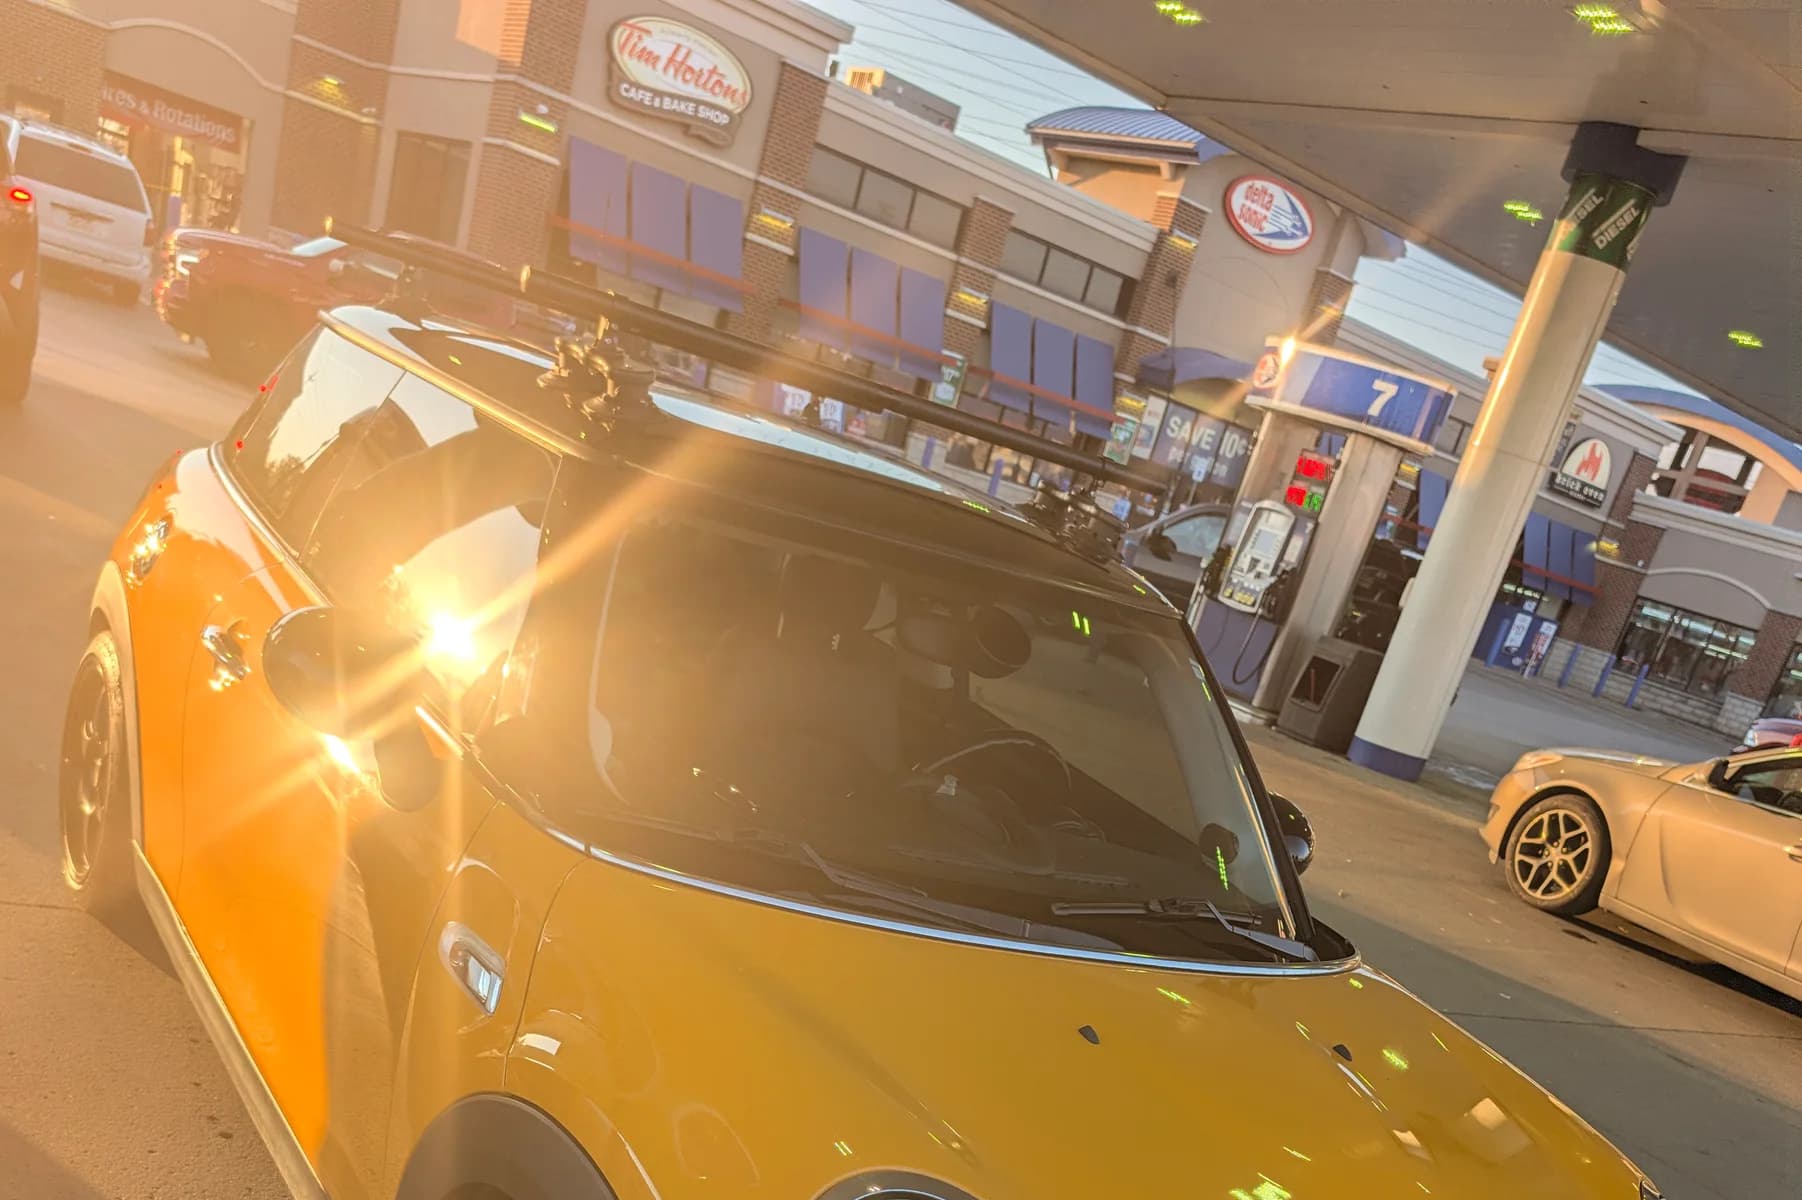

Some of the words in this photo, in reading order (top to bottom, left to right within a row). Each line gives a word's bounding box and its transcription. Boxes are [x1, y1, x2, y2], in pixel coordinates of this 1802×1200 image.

[619, 20, 661, 71] Tim
[663, 42, 749, 106] Hortons
[101, 82, 136, 109] ires
[153, 99, 236, 144] Rotations
[620, 83, 654, 106] CAFE
[662, 96, 697, 116] BAKE
[698, 104, 731, 126] SHOP
[1244, 182, 1275, 212] delta
[1238, 203, 1268, 232] sonic
[1594, 206, 1641, 250] DIESEL
[1367, 379, 1399, 417] 7
[1166, 415, 1217, 451] SAVE
